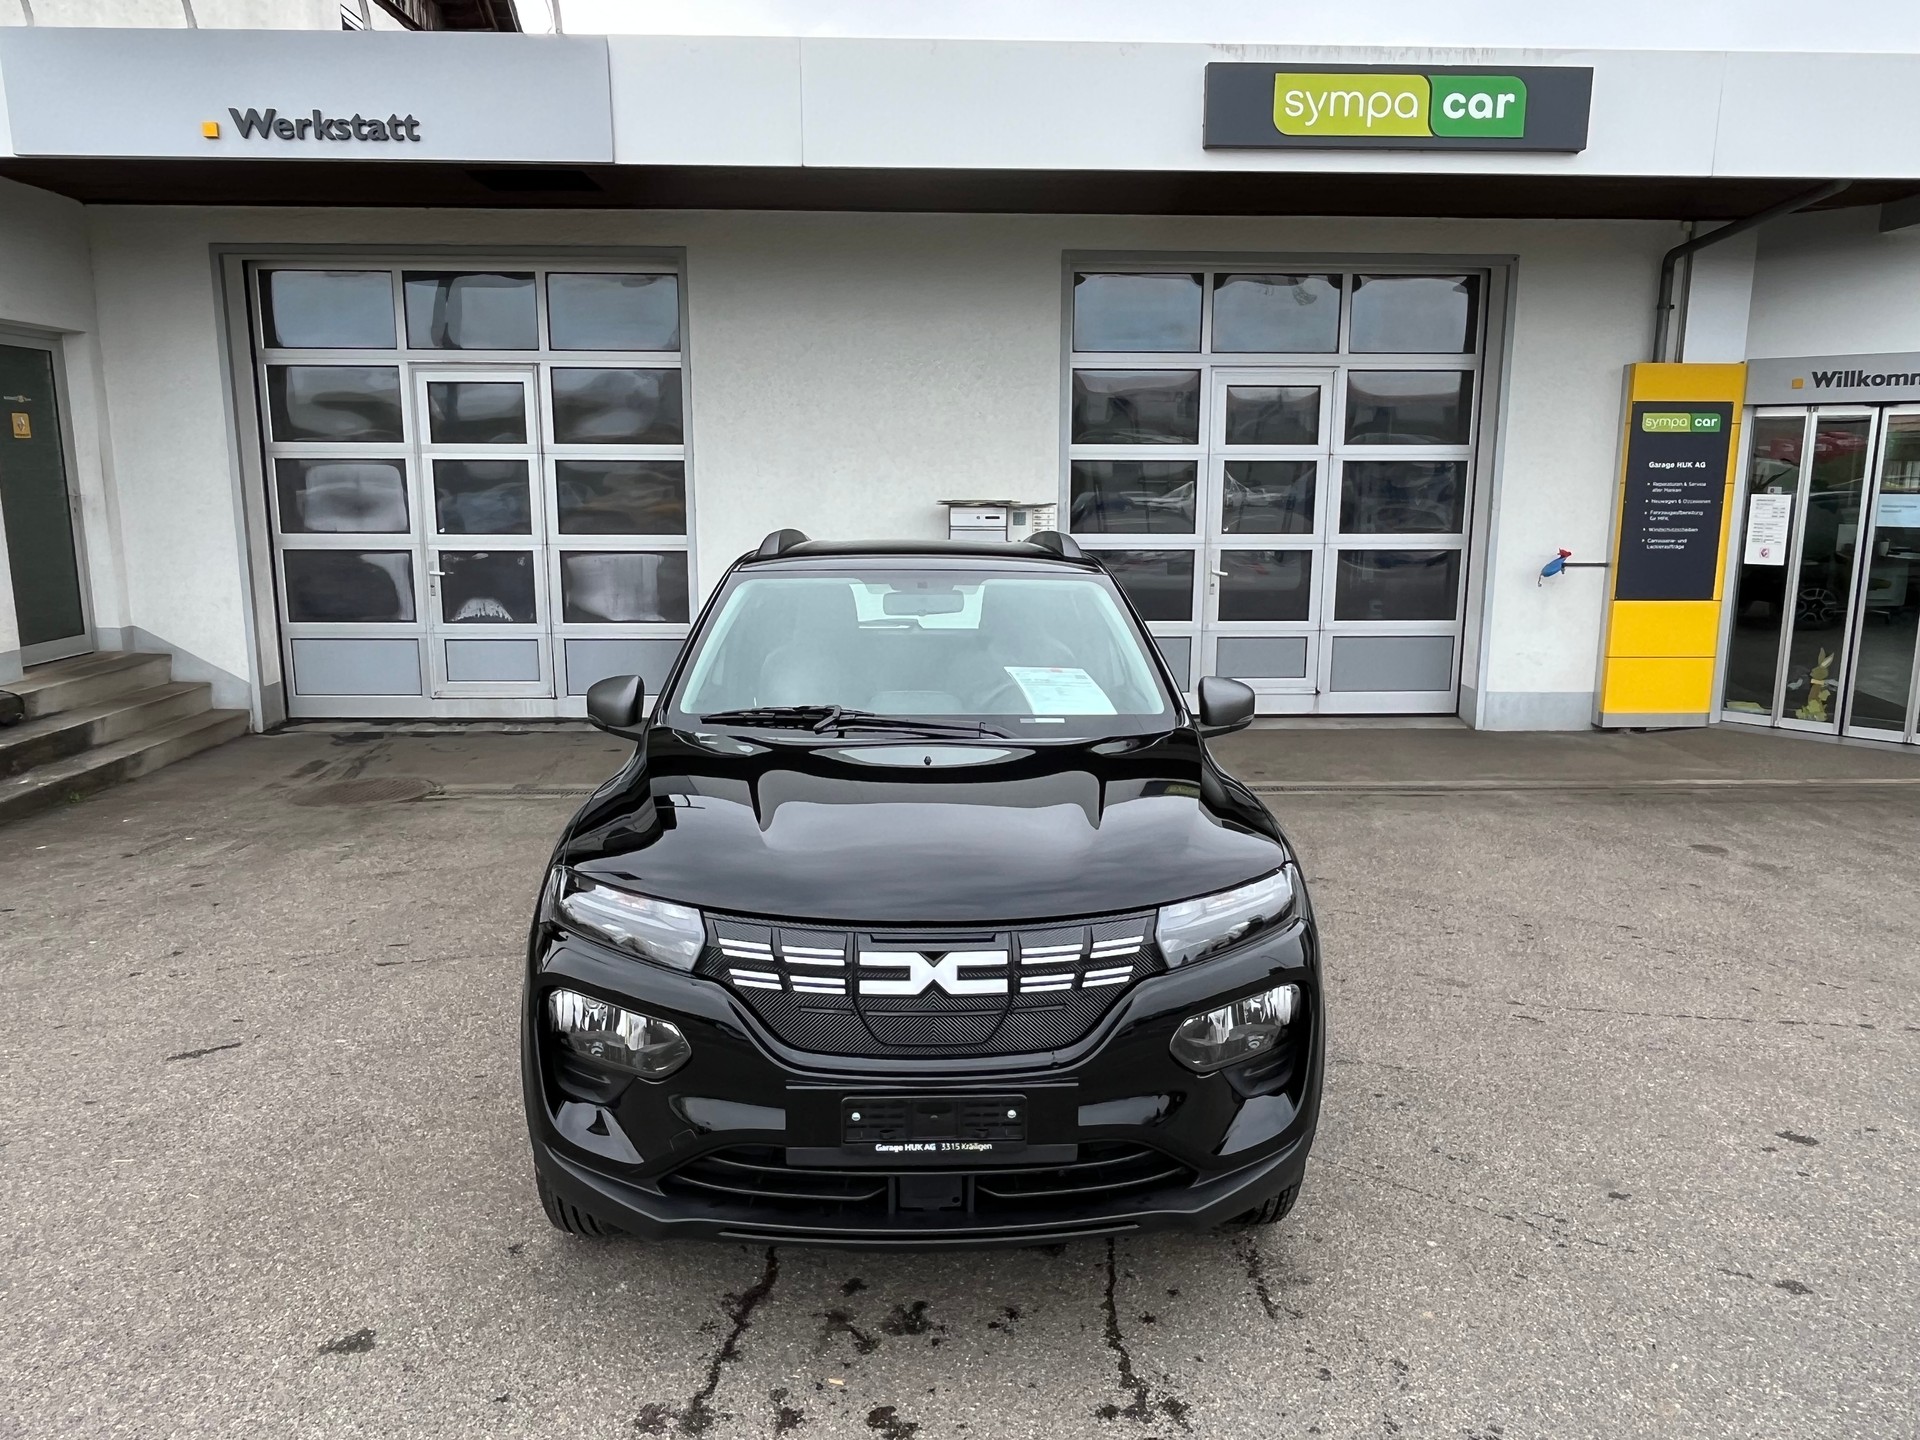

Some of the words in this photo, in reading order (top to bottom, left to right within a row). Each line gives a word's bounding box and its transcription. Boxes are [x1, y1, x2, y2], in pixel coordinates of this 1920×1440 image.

[1284, 89, 1418, 127] sympa
[1442, 92, 1515, 119] car
[228, 107, 421, 141] Werkstatt
[1645, 418, 1688, 429] sympa
[1694, 418, 1718, 427] car
[1648, 461, 1675, 469] Garage
[875, 1144, 903, 1152] Garage
[904, 1143, 924, 1151] HUK
[924, 1143, 936, 1151] AG
[941, 1143, 960, 1151] 3315
